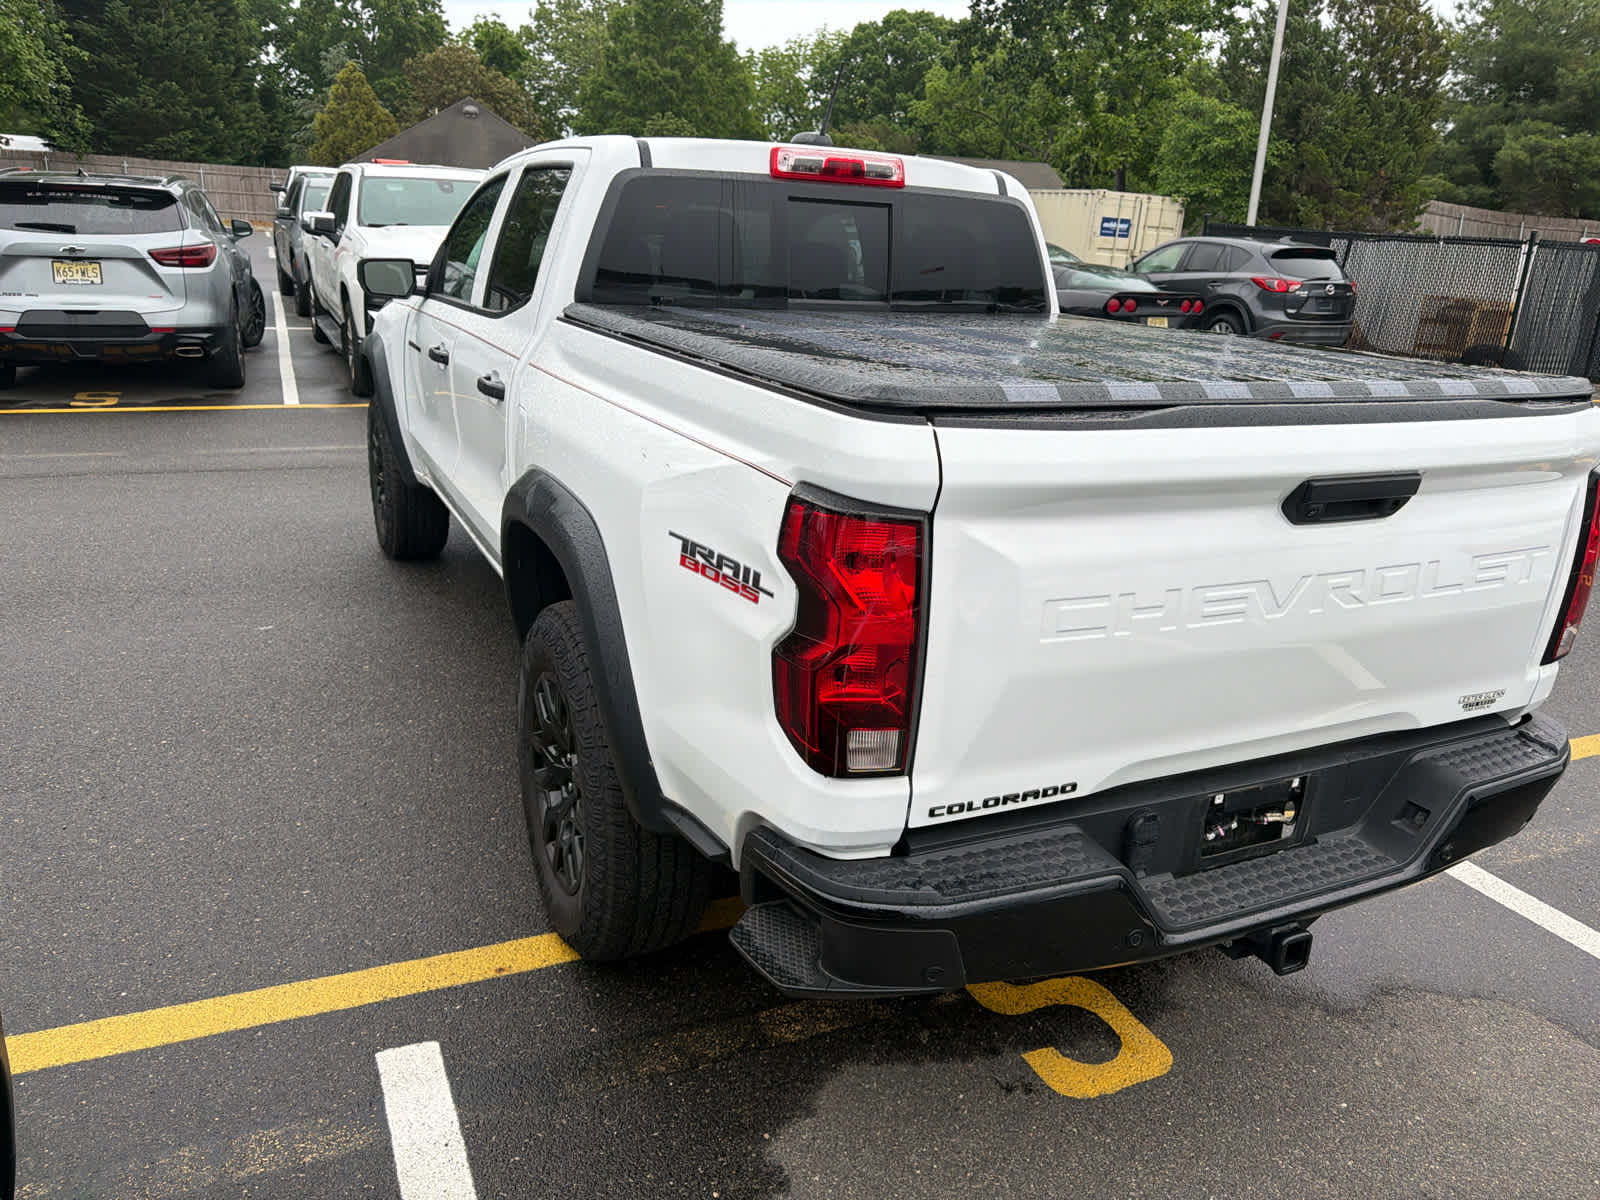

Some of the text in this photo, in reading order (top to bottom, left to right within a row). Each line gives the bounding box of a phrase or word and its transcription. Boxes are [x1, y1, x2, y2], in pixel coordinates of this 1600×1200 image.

[668, 530, 774, 598] TRAIL
[679, 553, 760, 604] BOSS
[1040, 546, 1555, 644] CHEVROLET
[928, 781, 1078, 818] COLORADO
